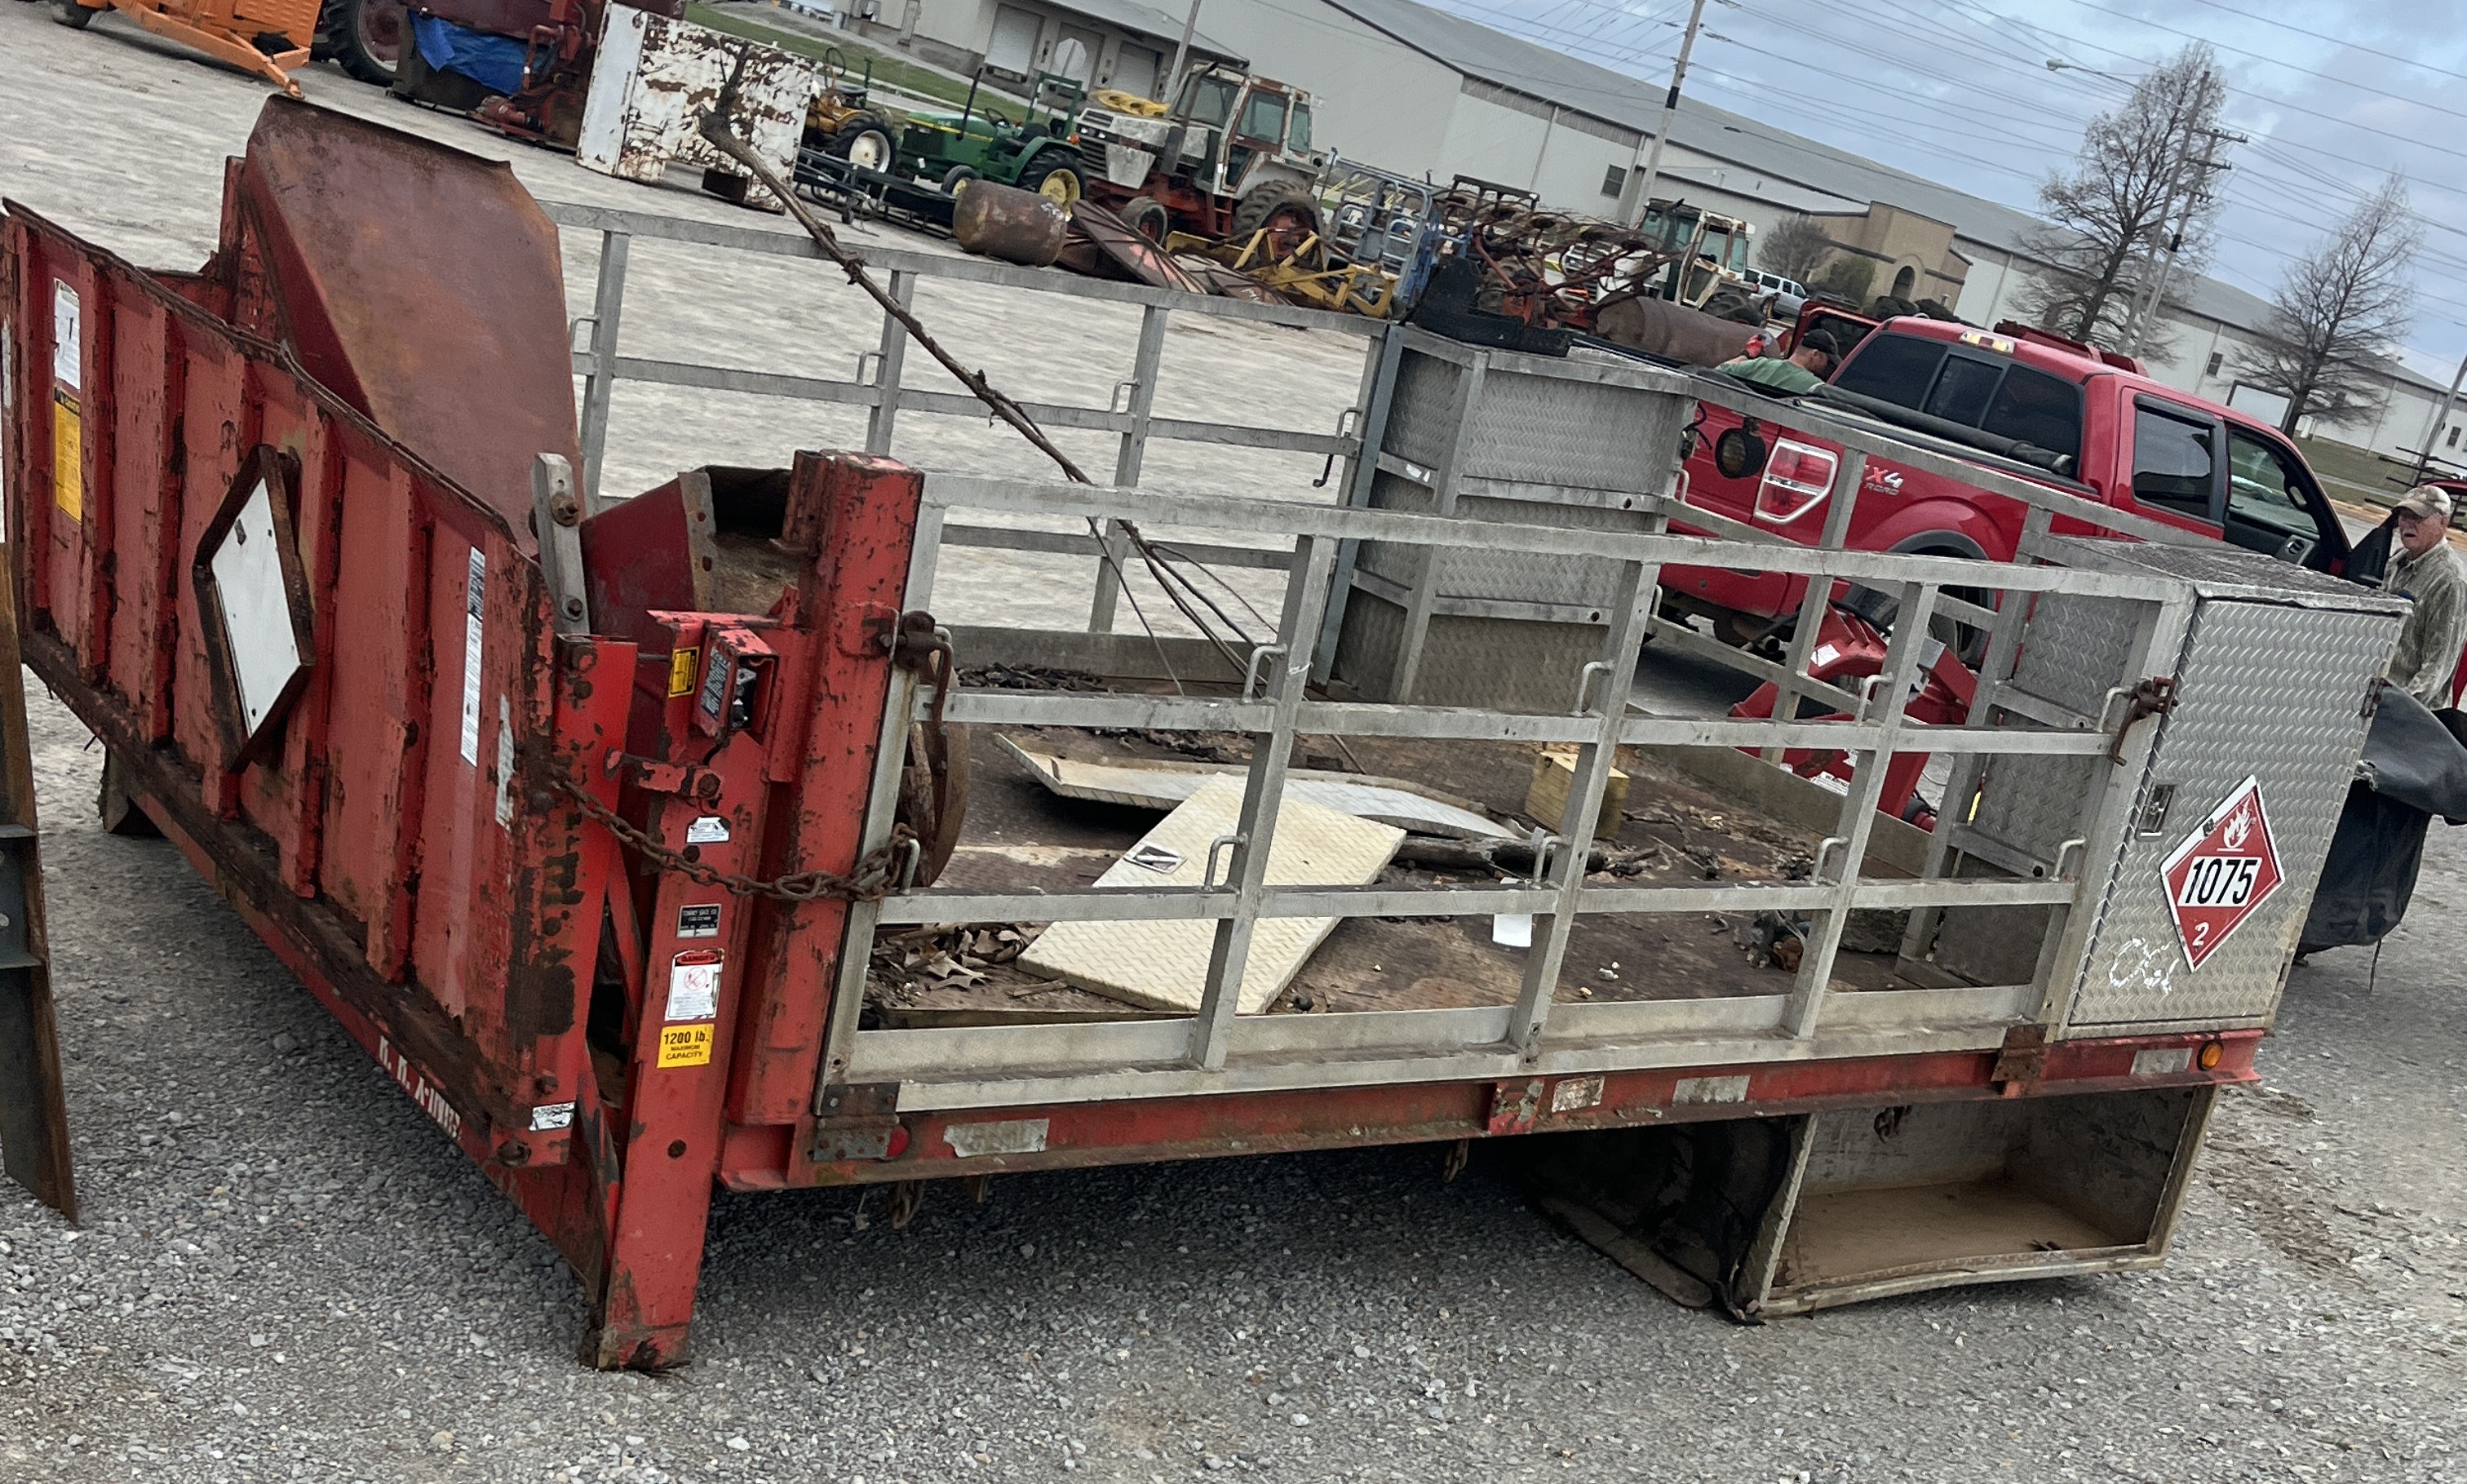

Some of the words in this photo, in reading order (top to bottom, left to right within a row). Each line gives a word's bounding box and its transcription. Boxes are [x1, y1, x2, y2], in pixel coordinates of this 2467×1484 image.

[1864, 464, 1904, 489] X4
[2185, 857, 2258, 905] 1075
[2191, 921, 2210, 946] 2
[663, 1030, 692, 1045] 1200
[666, 1051, 703, 1061] CAPACITY
